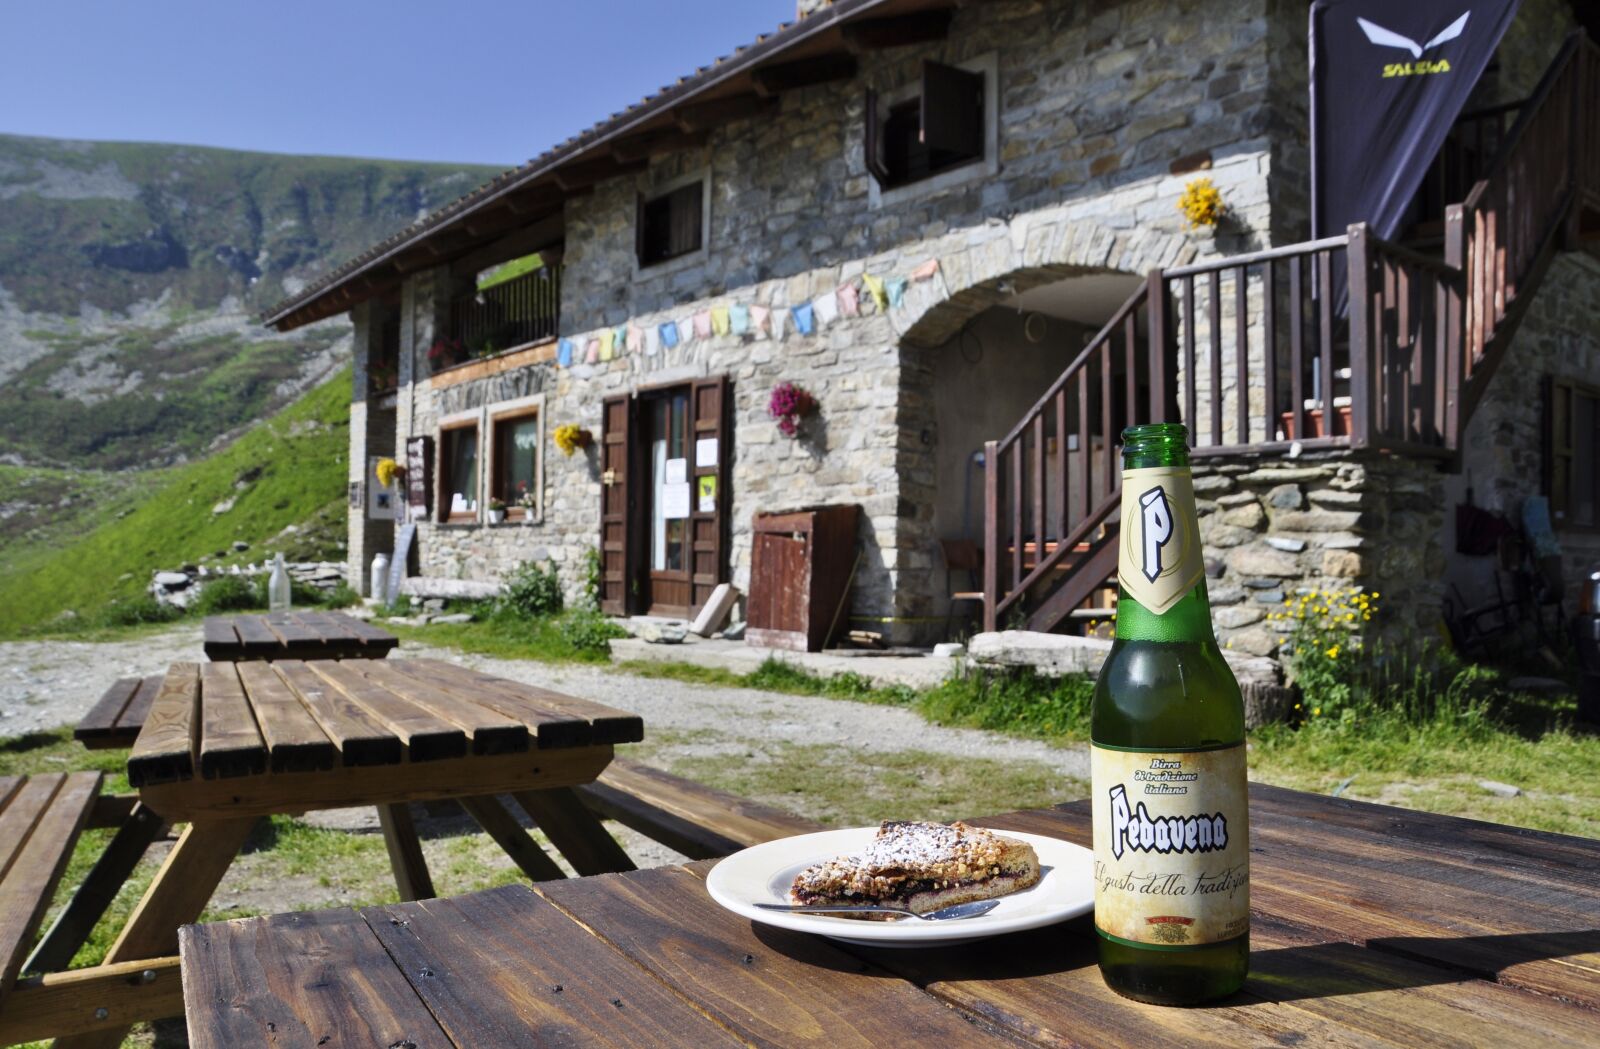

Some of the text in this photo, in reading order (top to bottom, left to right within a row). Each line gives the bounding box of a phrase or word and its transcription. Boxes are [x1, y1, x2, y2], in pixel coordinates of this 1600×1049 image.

[1382, 59, 1451, 78] SALEWA
[1139, 485, 1174, 584] P
[1150, 758, 1181, 769] Birra
[1135, 770, 1198, 781] di tradizione
[1144, 783, 1188, 795] italiana
[1109, 783, 1228, 861] Pedavena
[1095, 860, 1105, 882] Il
[1103, 870, 1136, 893] gusto
[1140, 872, 1188, 895] della
